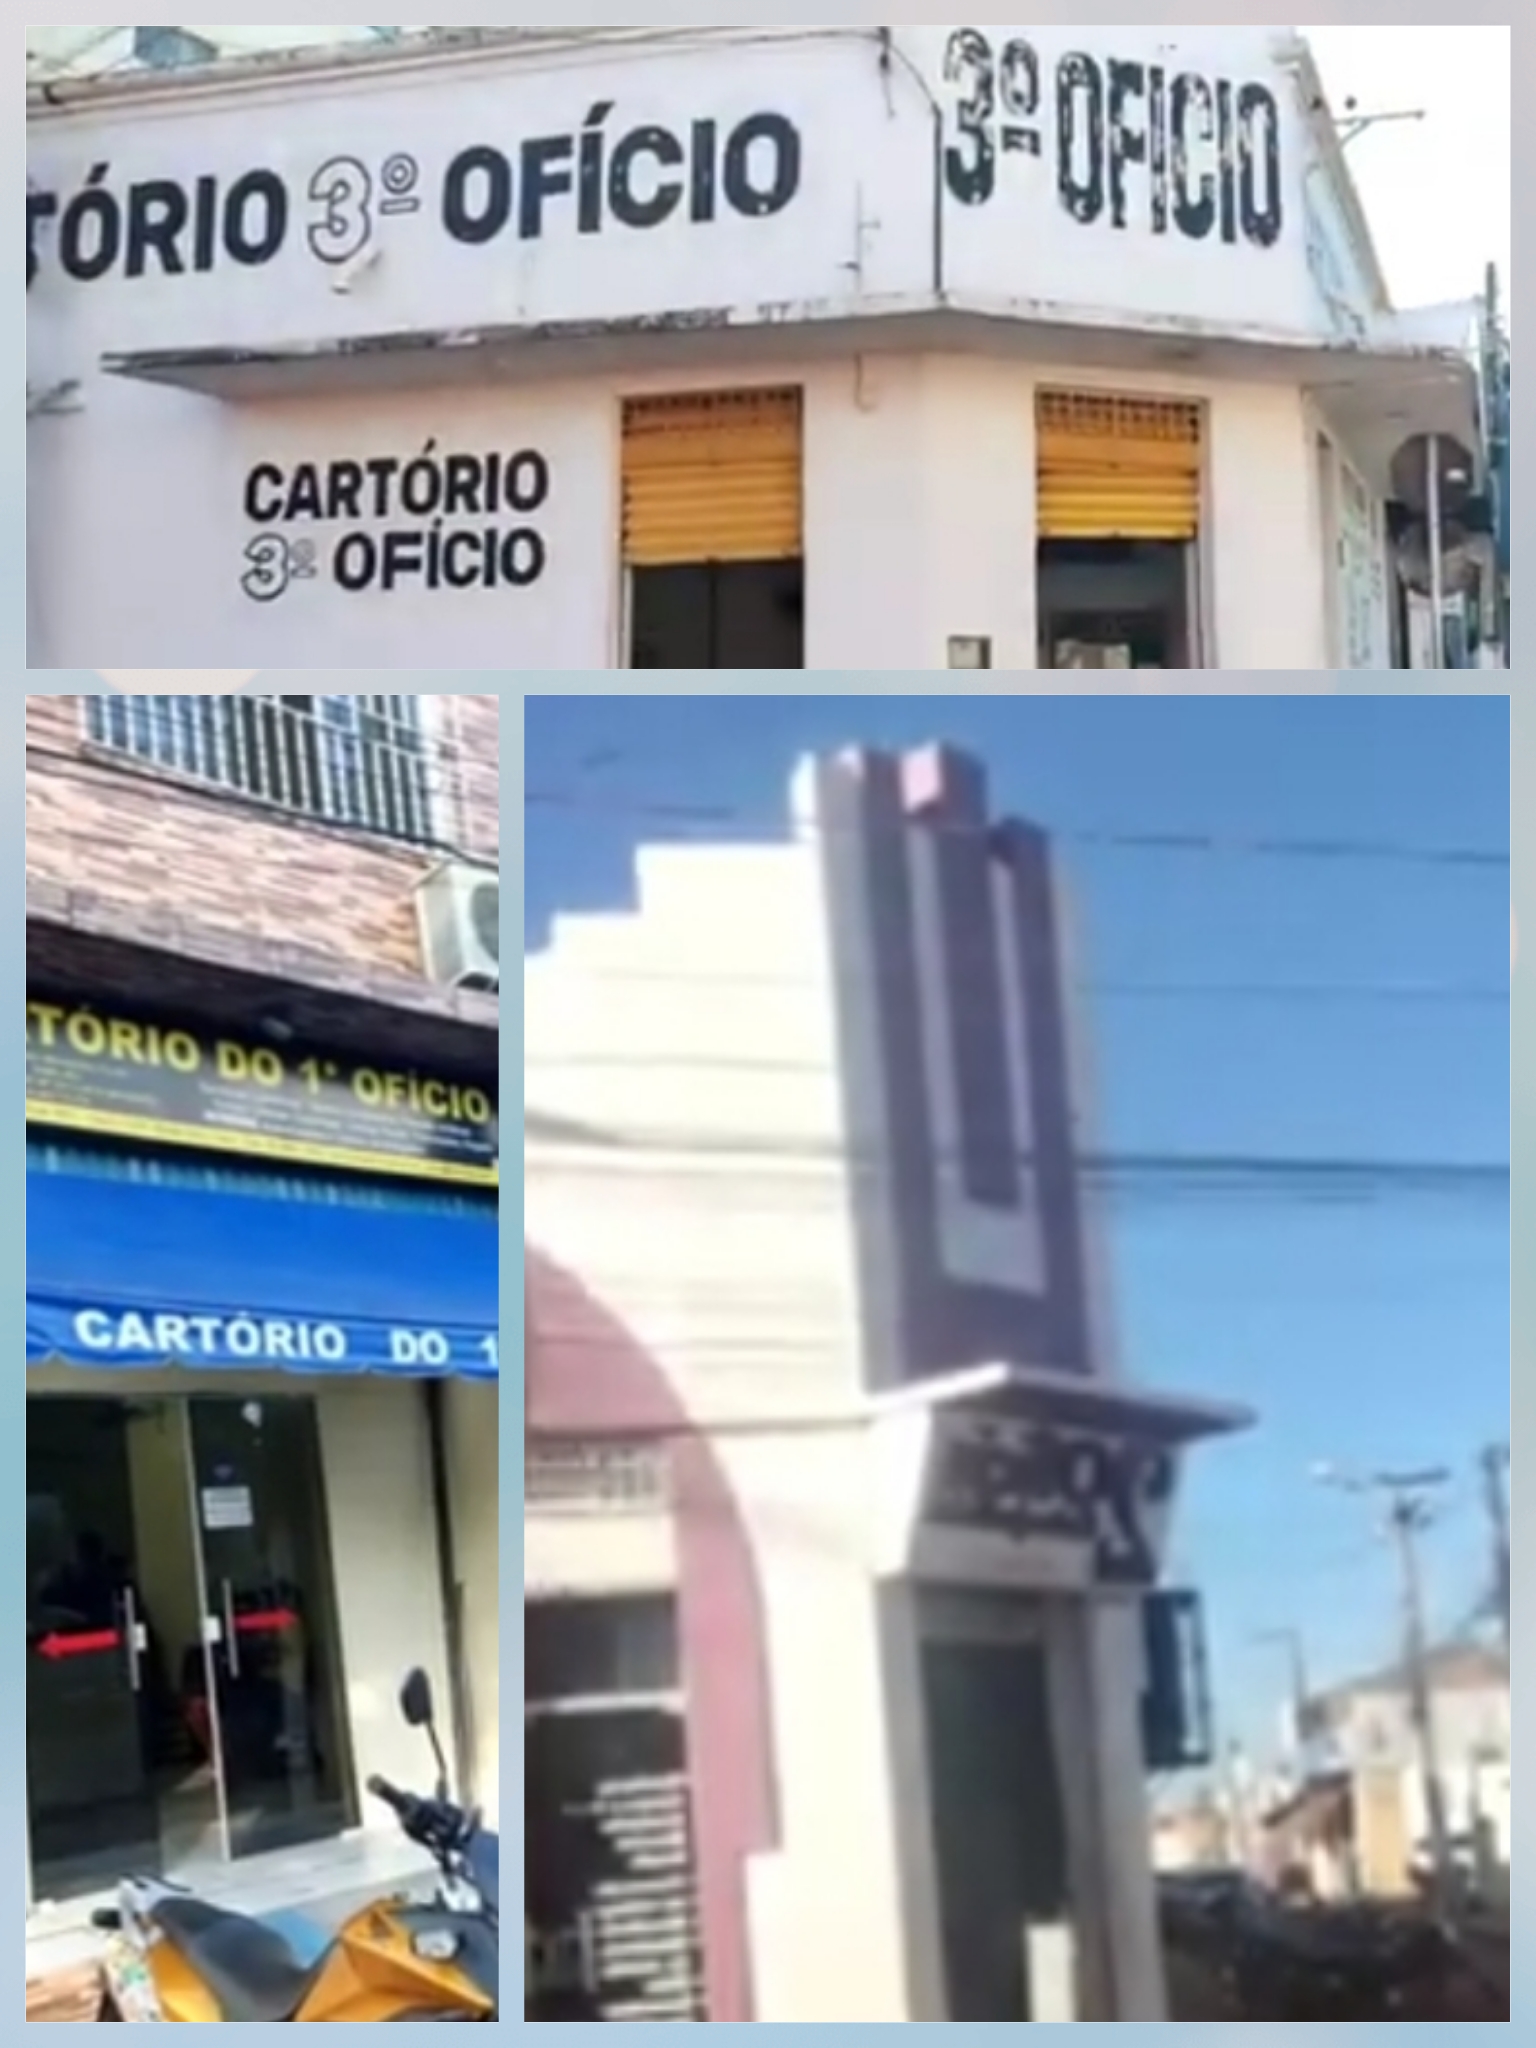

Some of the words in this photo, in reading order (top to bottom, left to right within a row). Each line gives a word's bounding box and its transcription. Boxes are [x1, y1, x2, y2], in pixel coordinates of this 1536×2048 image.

[441, 101, 802, 244] OFÍCIO
[243, 439, 549, 522] CARTÓRIO
[333, 518, 545, 591] OFÍCIO
[26, 1002, 200, 1074] TÓRIO
[215, 1040, 284, 1087] DO
[73, 1309, 347, 1360] CARTÓRIO
[391, 1328, 450, 1366] DO
